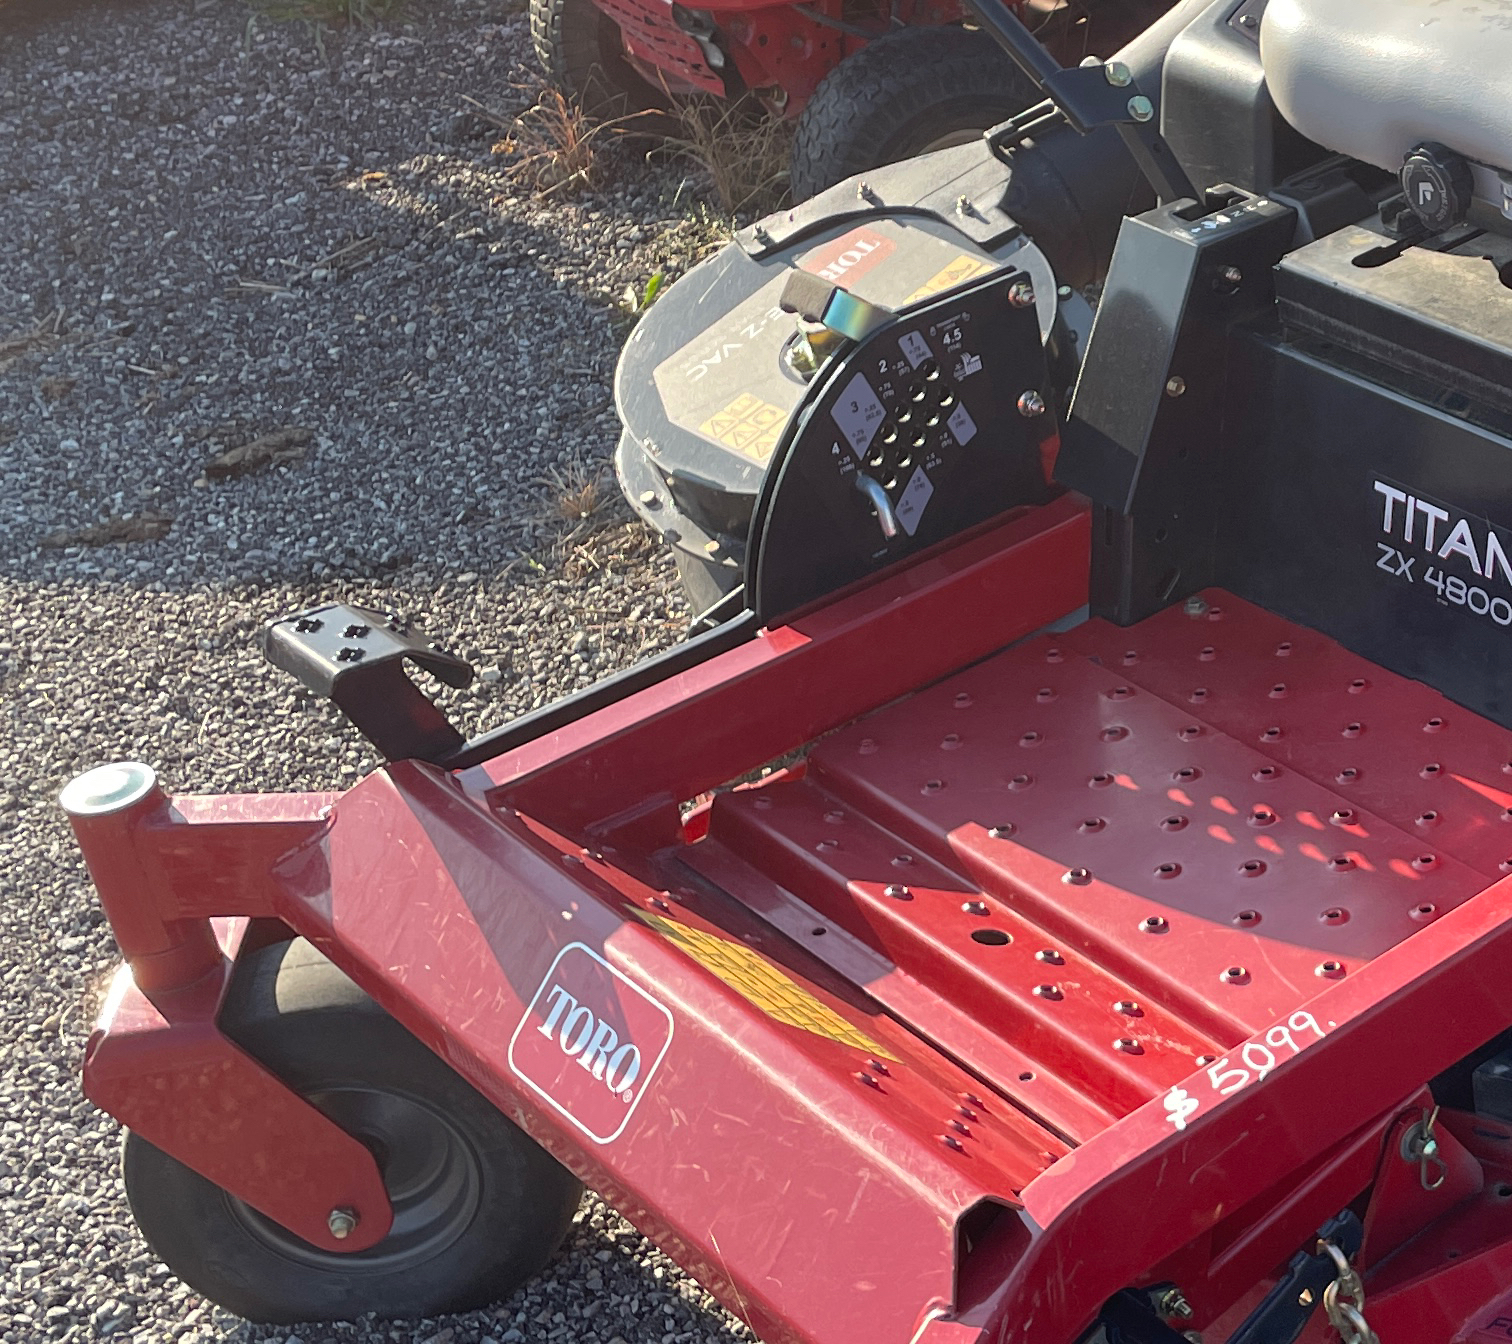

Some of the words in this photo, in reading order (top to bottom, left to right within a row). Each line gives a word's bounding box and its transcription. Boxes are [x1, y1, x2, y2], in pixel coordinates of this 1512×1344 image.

[907, 335, 914, 347] 1
[943, 327, 962, 345] 4.5
[686, 344, 743, 381] VAC
[878, 359, 888, 373] 2
[850, 400, 859, 413] 3
[831, 441, 840, 455] 4
[1376, 542, 1415, 583] ZX
[1424, 566, 1512, 625] 4800
[537, 984, 641, 1094] TORO
